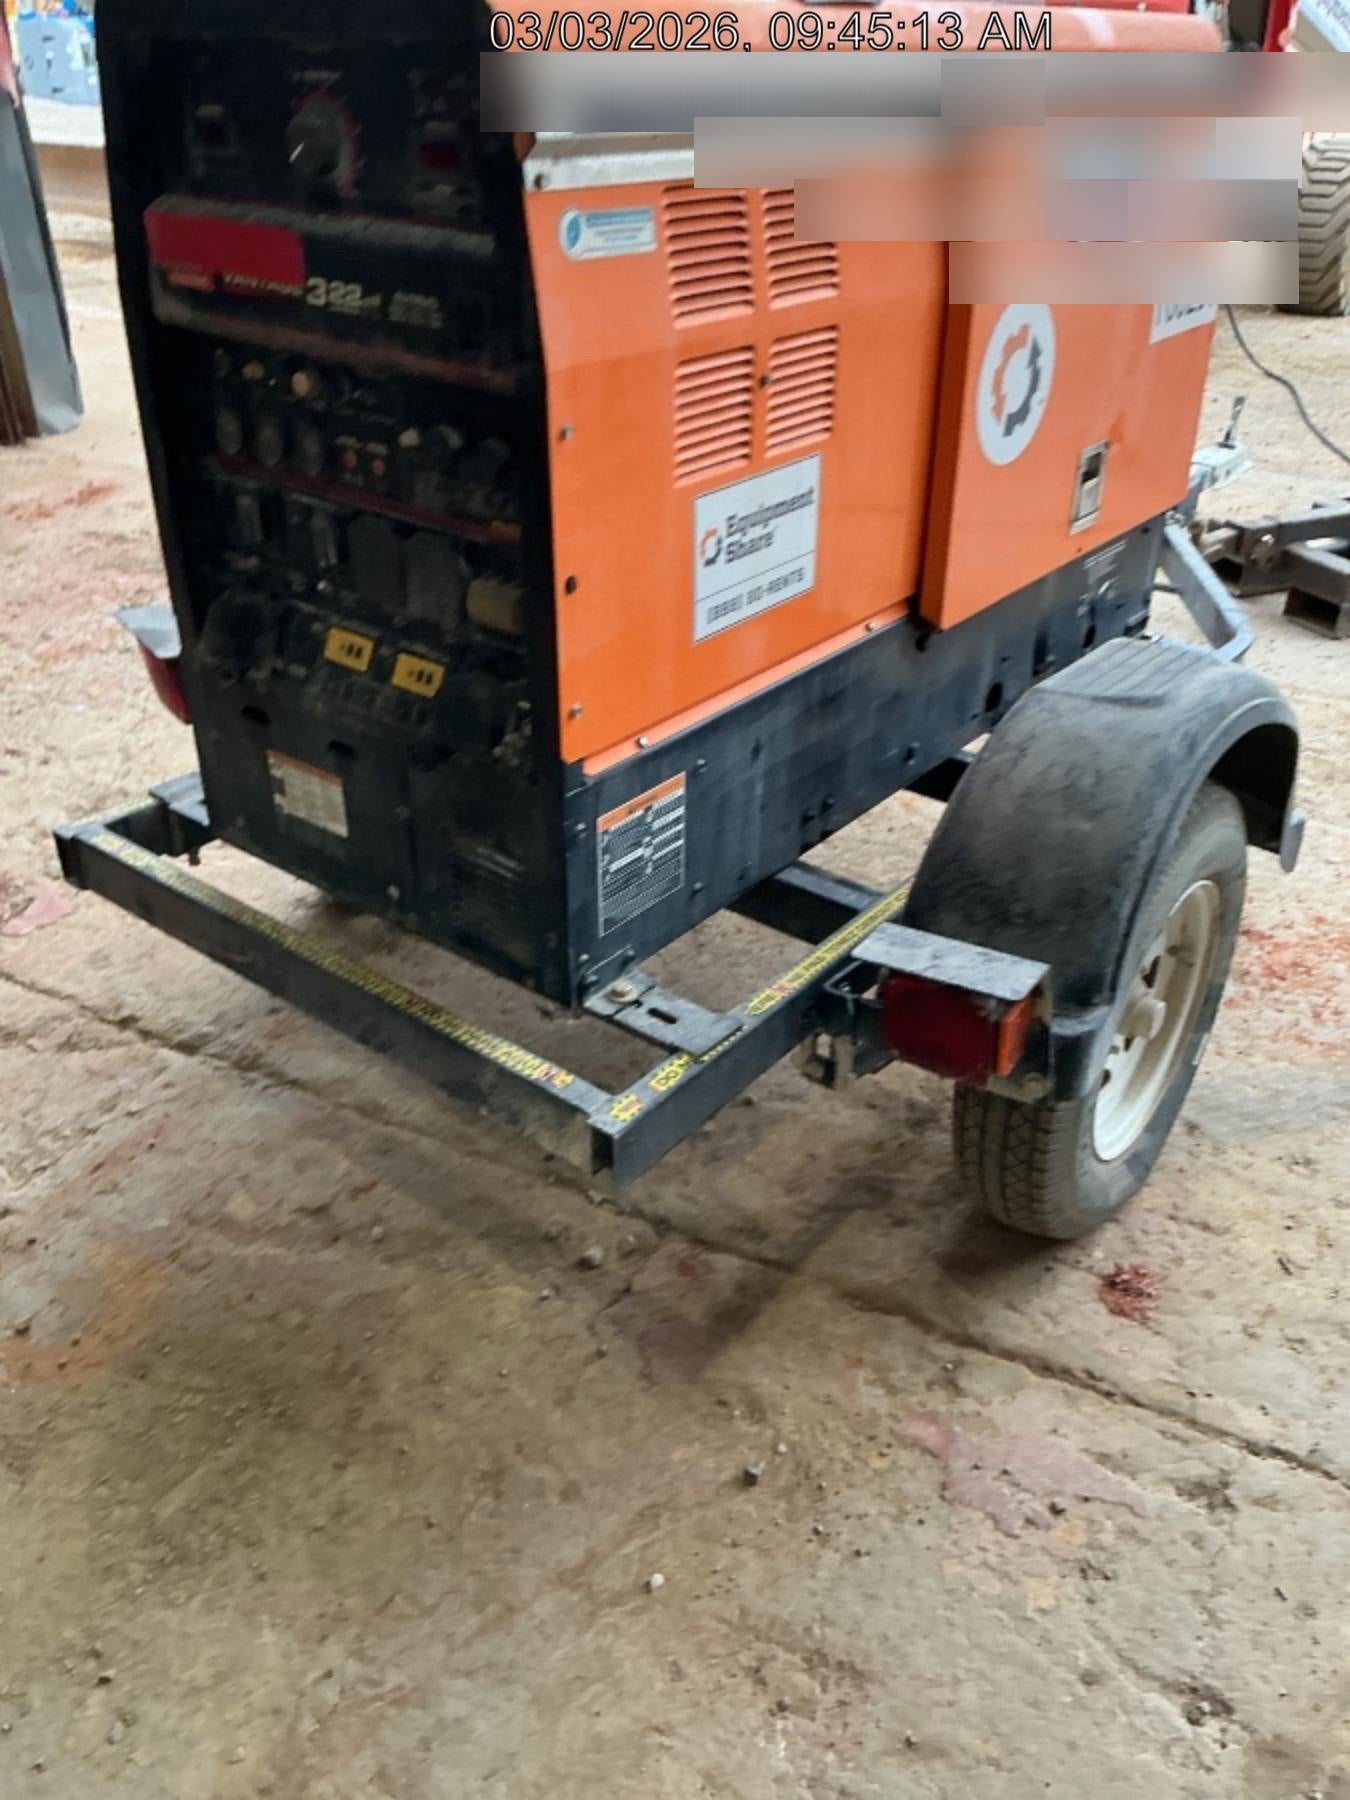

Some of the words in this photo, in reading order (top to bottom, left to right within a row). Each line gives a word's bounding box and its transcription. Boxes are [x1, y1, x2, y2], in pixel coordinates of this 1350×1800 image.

[306, 275, 363, 306] 322
[727, 486, 814, 537] Equipment
[726, 531, 775, 564] Share
